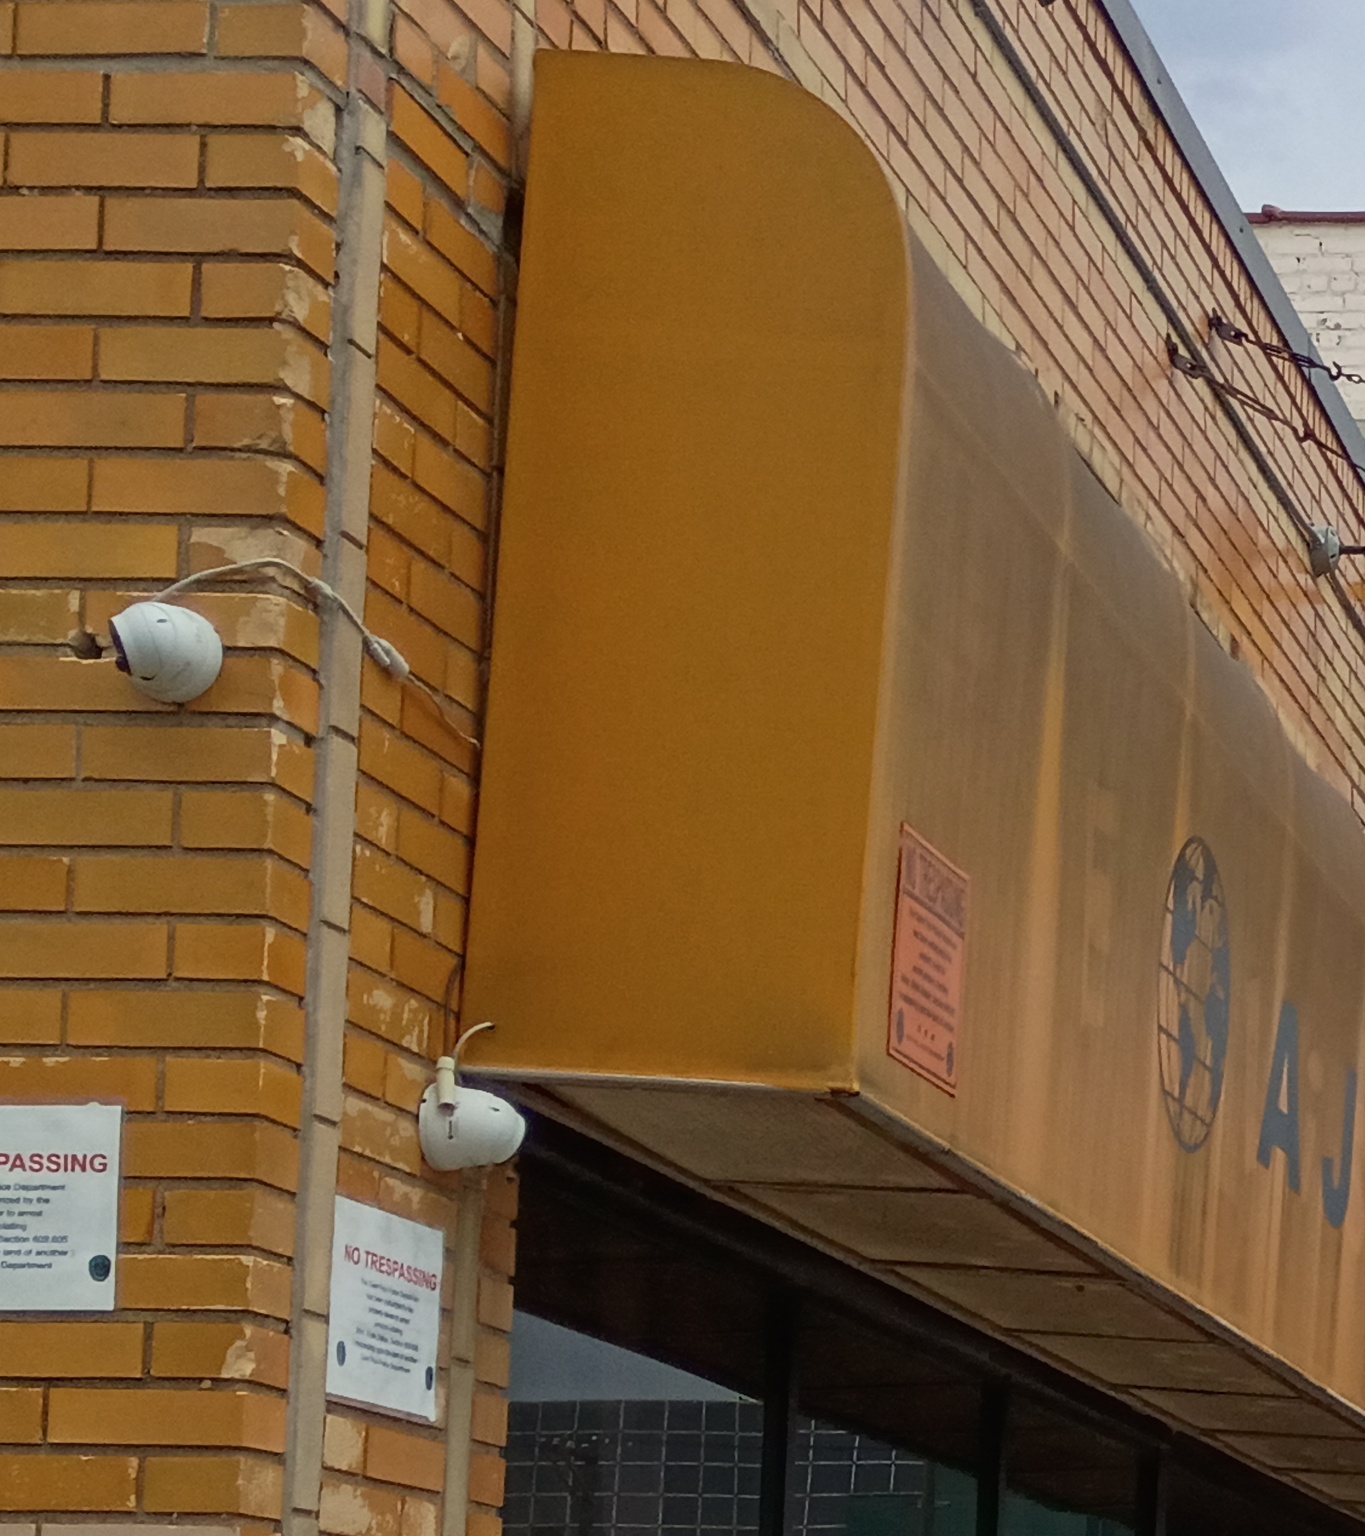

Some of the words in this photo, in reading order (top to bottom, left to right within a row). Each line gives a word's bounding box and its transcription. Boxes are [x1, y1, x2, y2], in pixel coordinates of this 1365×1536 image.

[1257, 1002, 1301, 1196] A
[1322, 1070, 1358, 1229] J
[344, 1244, 361, 1265] NO
[364, 1250, 438, 1291] TRESPASSING
